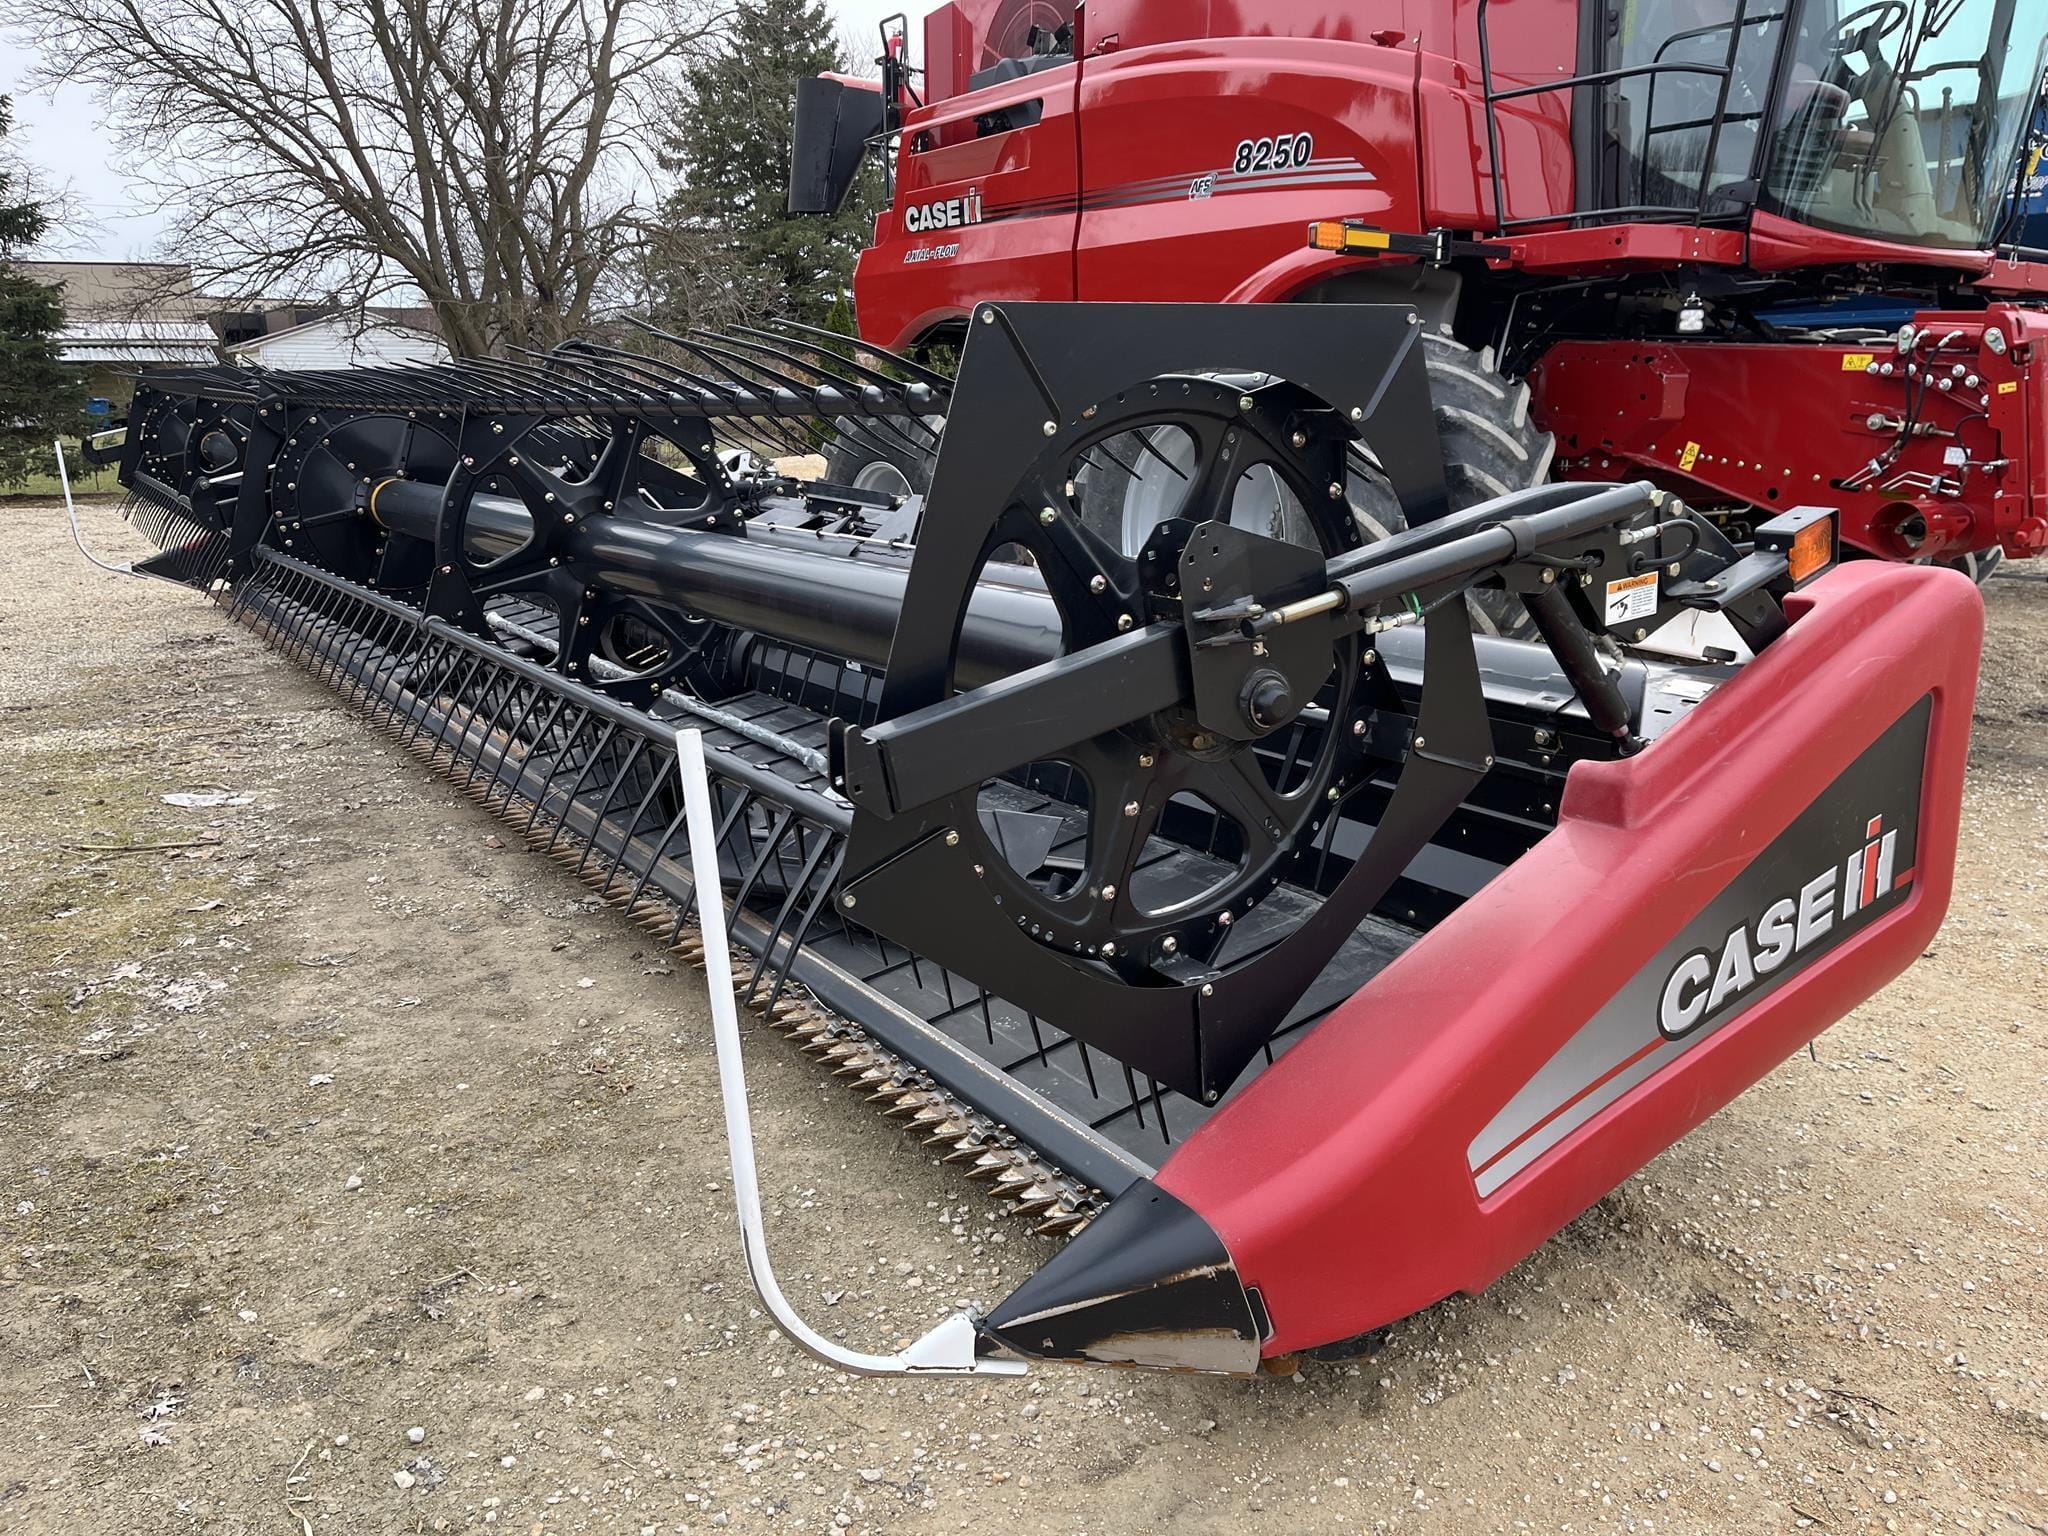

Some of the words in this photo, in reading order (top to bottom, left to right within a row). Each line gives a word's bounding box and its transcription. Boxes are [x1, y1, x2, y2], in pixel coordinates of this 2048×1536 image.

[1234, 132, 1313, 175] 8250
[1189, 177, 1212, 194] AFS
[905, 199, 961, 232] CASE
[904, 243, 960, 264] AXIAL-FLOW
[1660, 865, 1838, 1033] CASE
